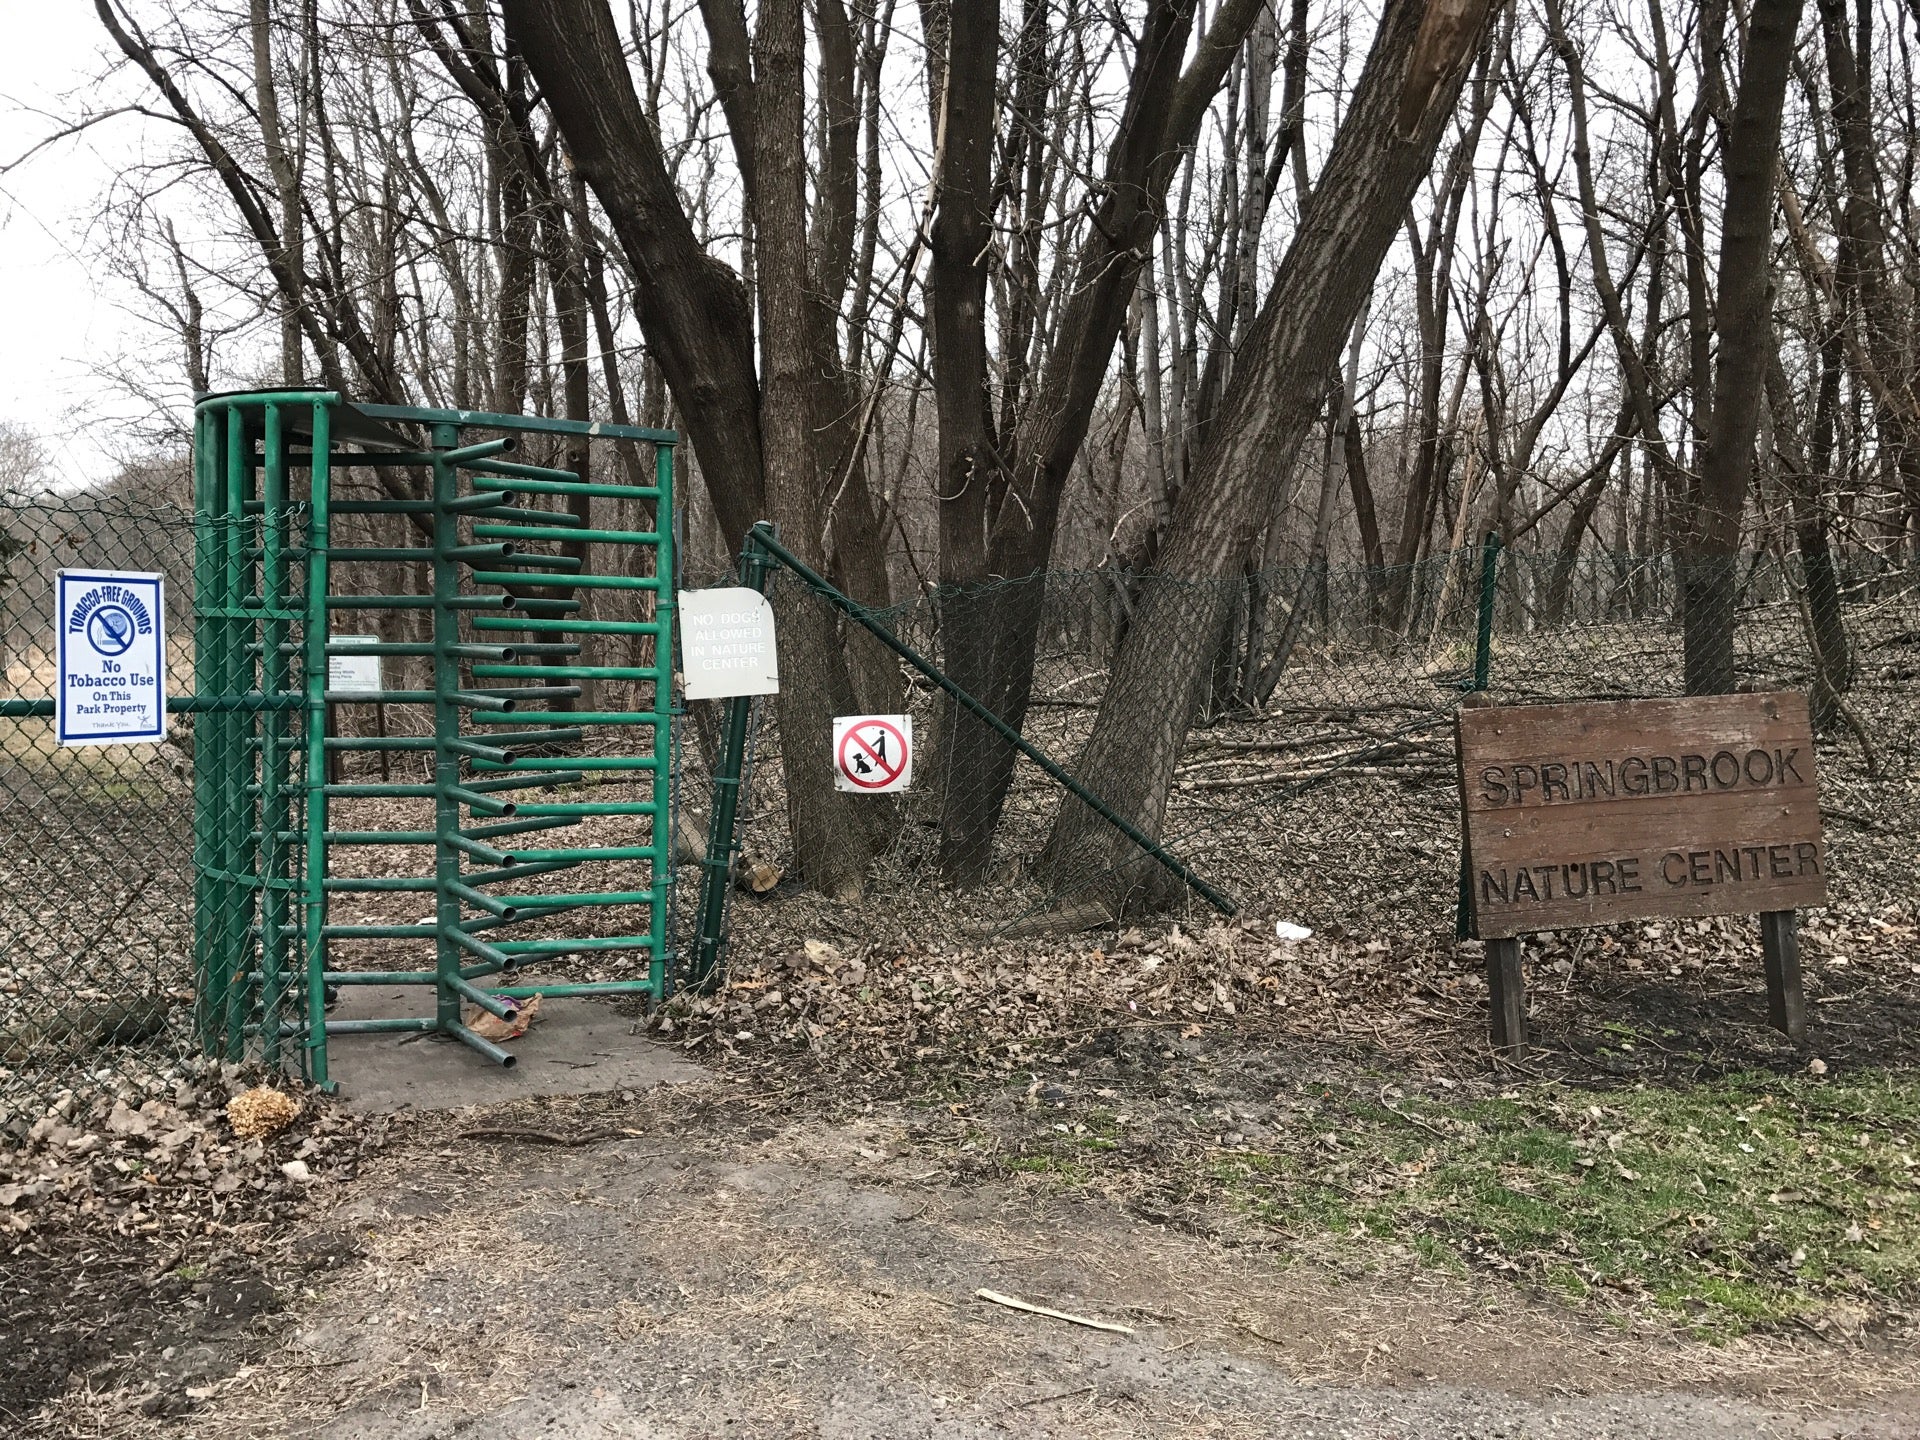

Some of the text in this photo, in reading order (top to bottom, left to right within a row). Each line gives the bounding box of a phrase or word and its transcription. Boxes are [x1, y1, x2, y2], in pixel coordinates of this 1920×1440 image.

[69, 586, 152, 635] TOBACCO-FREE GROUNDS
[693, 612, 761, 626] NO DOGS
[695, 627, 762, 640] ALLOWED
[691, 642, 766, 656] IN NATURE
[102, 660, 121, 673] No
[702, 657, 758, 670] CENTER
[68, 673, 154, 687] Tobacco Use
[93, 691, 131, 701] On This
[77, 703, 147, 715] Park Property
[1480, 748, 1804, 806] SPRINGBROOK
[1480, 842, 1820, 904] NATURE CENTER
